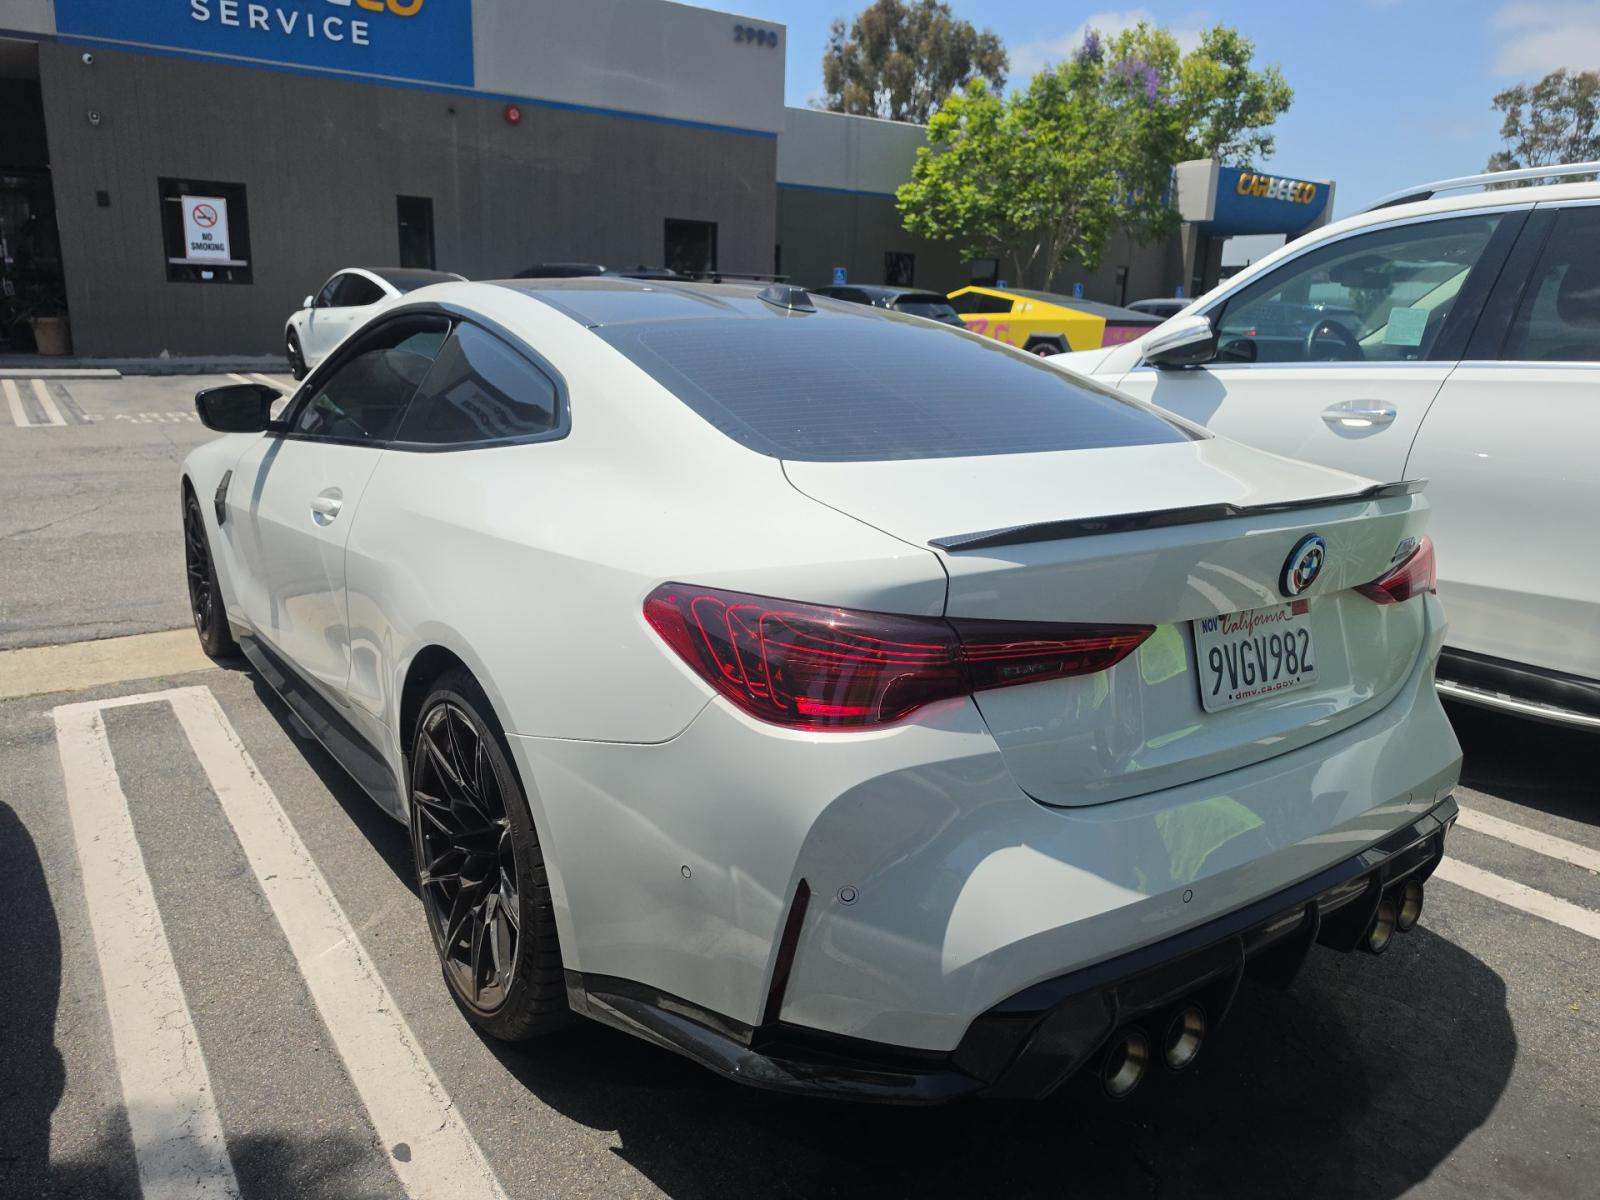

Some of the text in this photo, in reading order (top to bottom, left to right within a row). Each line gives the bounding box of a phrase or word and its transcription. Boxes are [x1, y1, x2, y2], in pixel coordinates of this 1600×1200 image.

[190, 0, 370, 46] SERVICE
[1236, 172, 1317, 205] CARBEECO
[191, 242, 225, 251] SMOKING
[202, 233, 213, 241] NO
[1202, 608, 1293, 637] NOV California
[1208, 628, 1314, 696] 9VGV982
[1235, 679, 1295, 700] dmv.ca.gov
